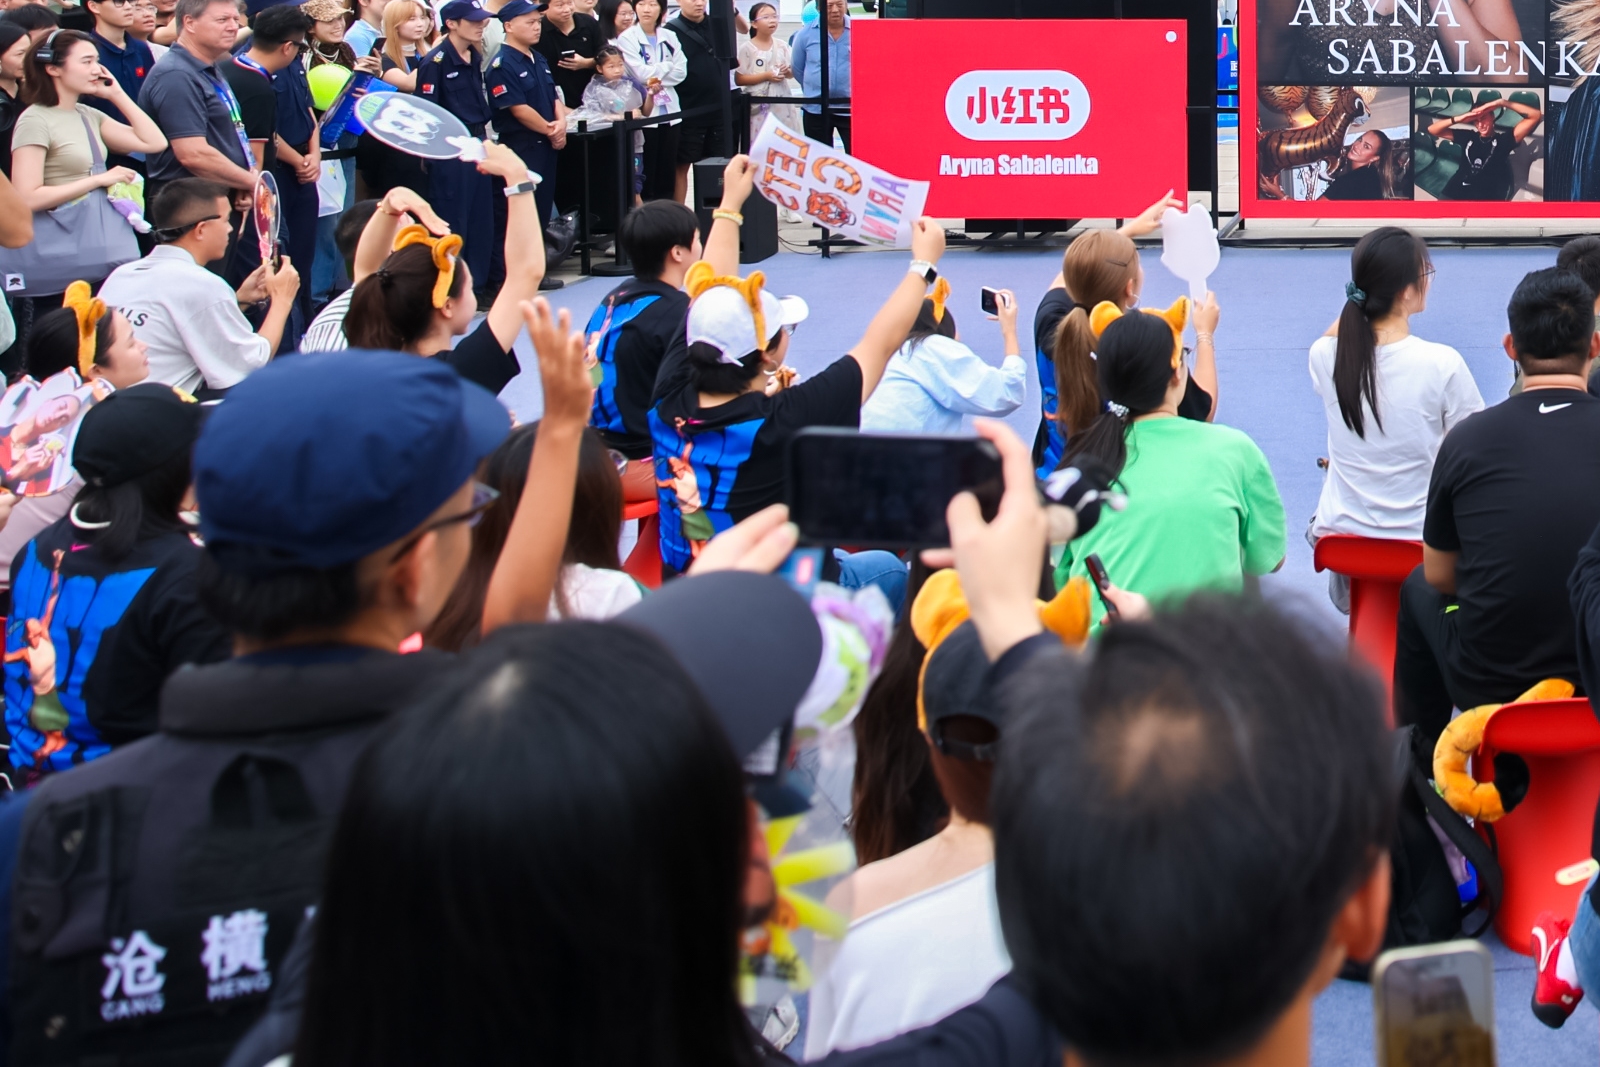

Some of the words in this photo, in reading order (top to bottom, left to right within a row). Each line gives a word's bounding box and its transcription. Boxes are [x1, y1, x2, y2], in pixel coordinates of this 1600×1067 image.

[966, 86, 1070, 125] 小红书
[939, 154, 995, 178] Aryna
[998, 154, 1099, 176] Sabalenka
[101, 993, 165, 1022] CANG
[207, 971, 271, 1003] HENG
